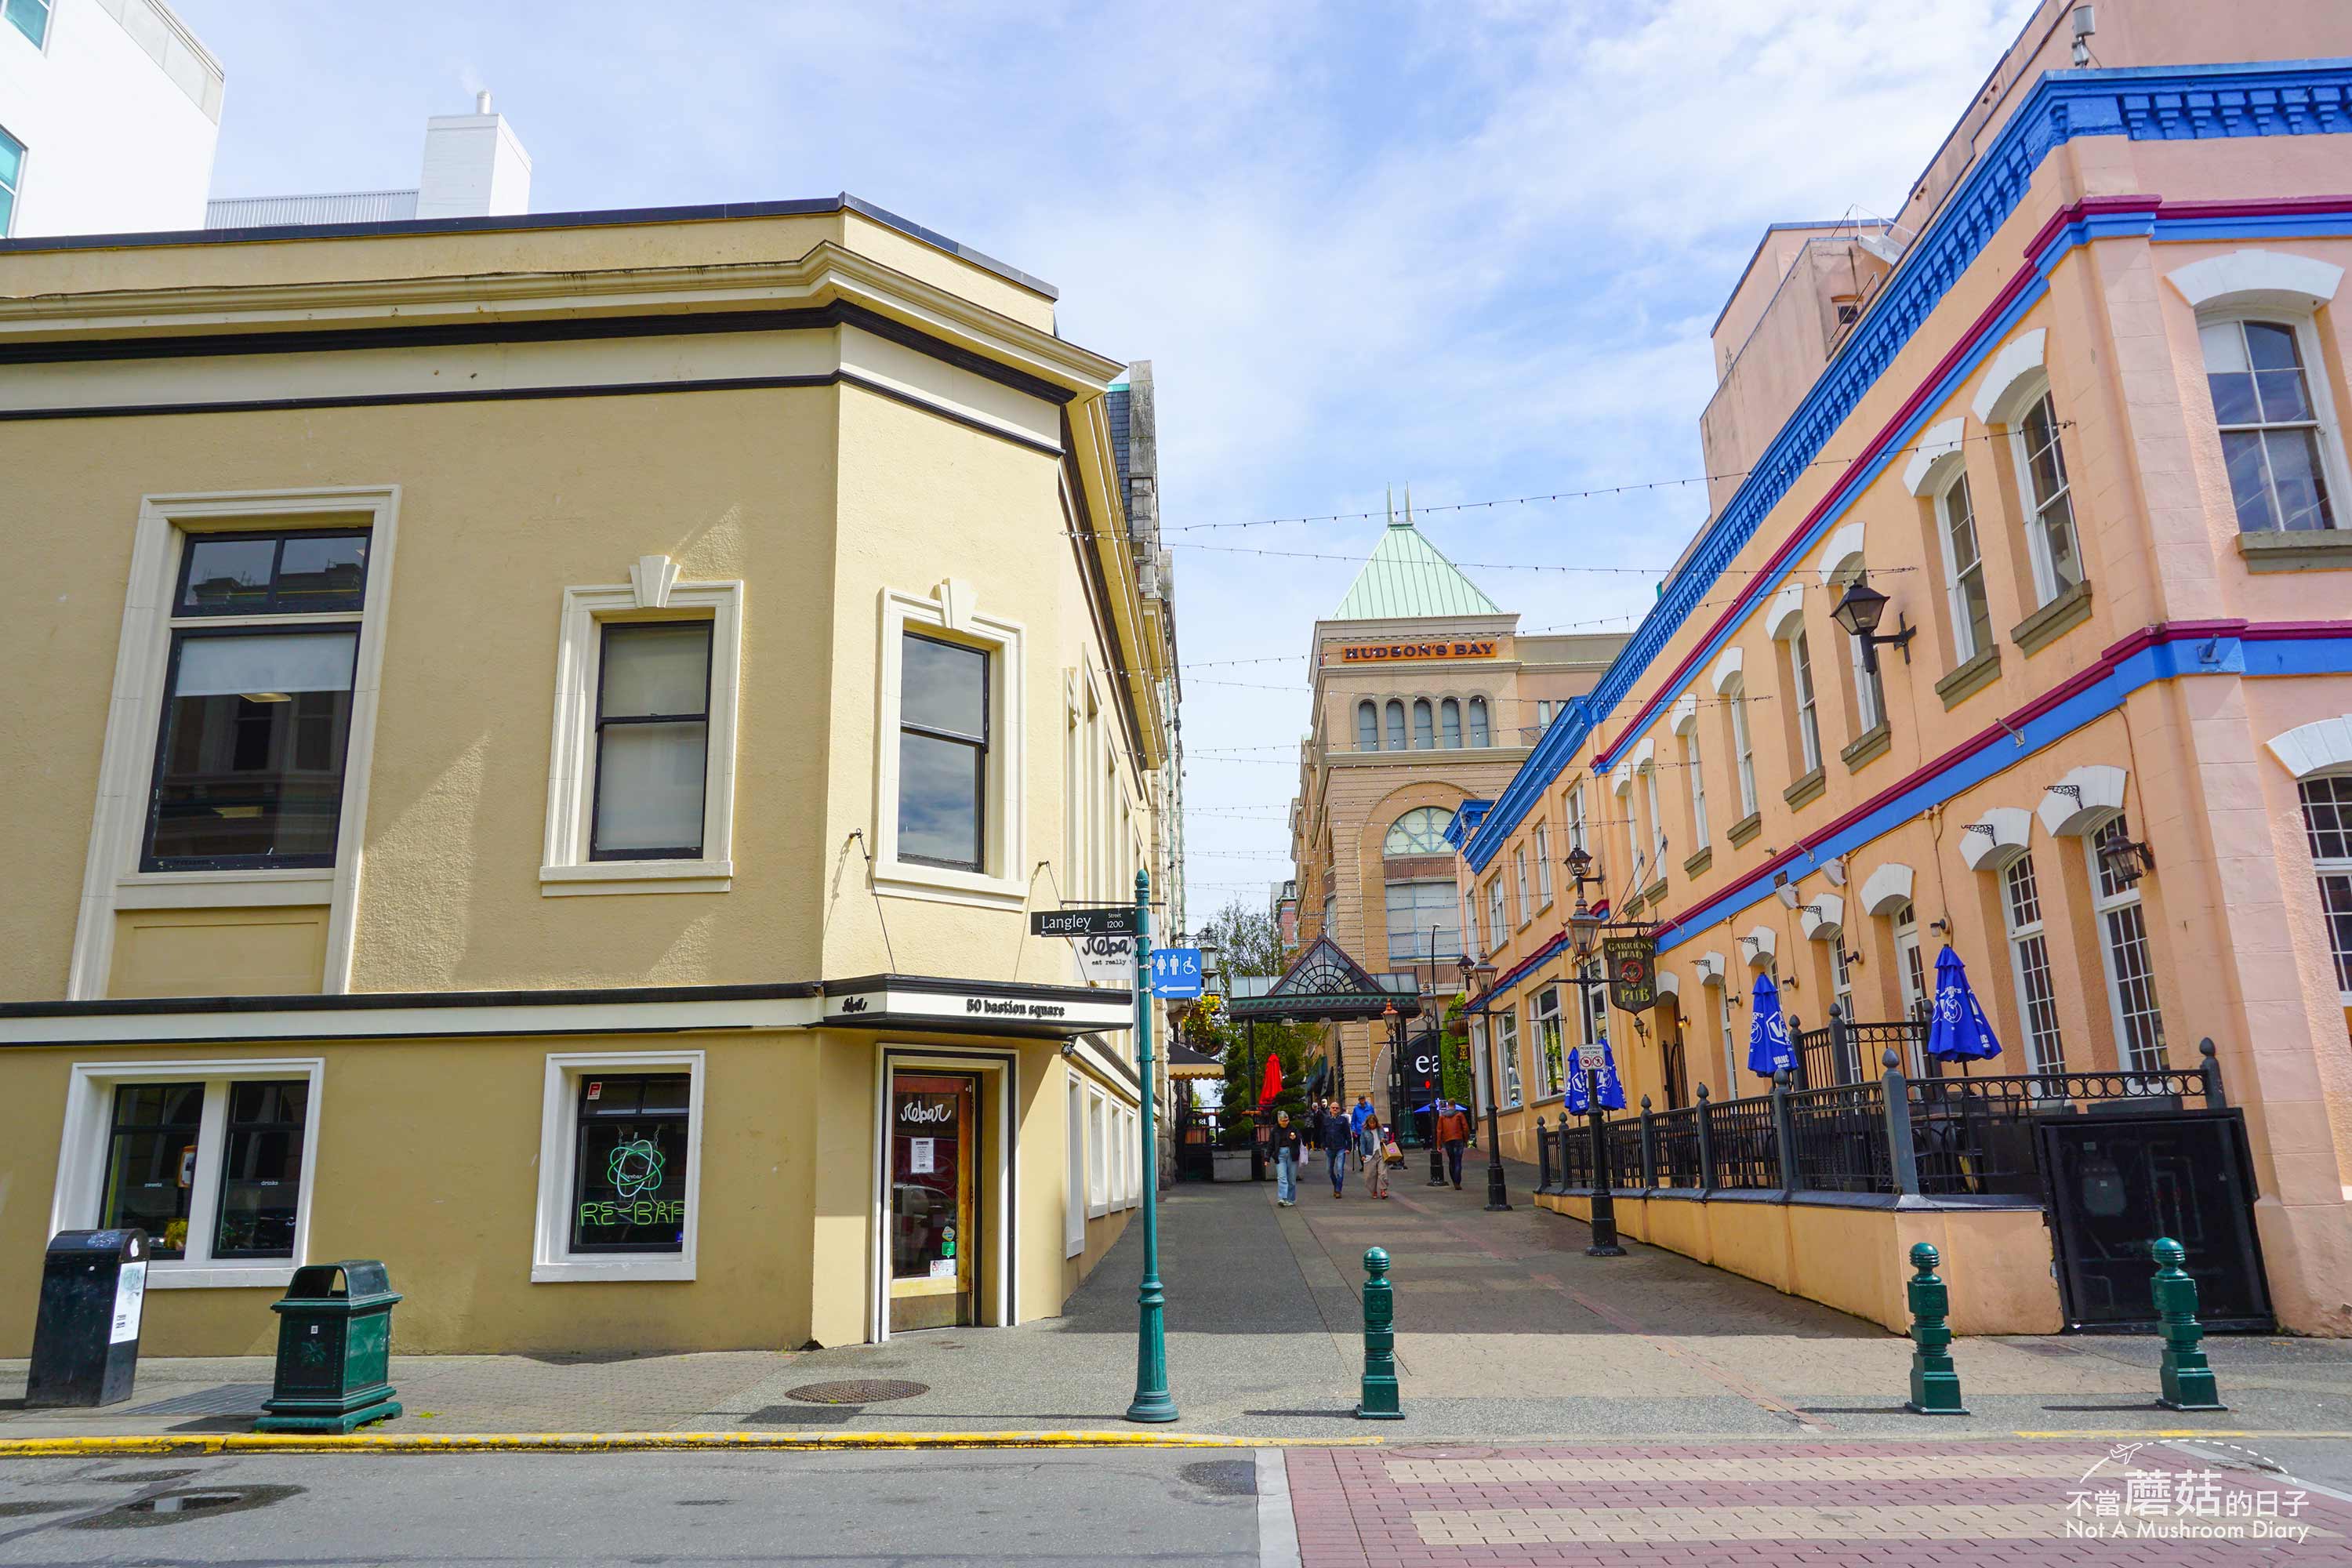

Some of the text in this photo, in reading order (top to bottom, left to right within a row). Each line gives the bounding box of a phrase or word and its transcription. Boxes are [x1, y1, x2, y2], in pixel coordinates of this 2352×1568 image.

[1345, 643, 1494, 659] HUDSON'S BAY
[1042, 914, 1091, 930] Langley
[1107, 920, 1123, 929] 1200
[1617, 950, 1643, 960] HEAD
[1620, 988, 1650, 1002] PUB
[967, 998, 1065, 1018] 50 bastion square
[901, 1100, 952, 1124] rebar
